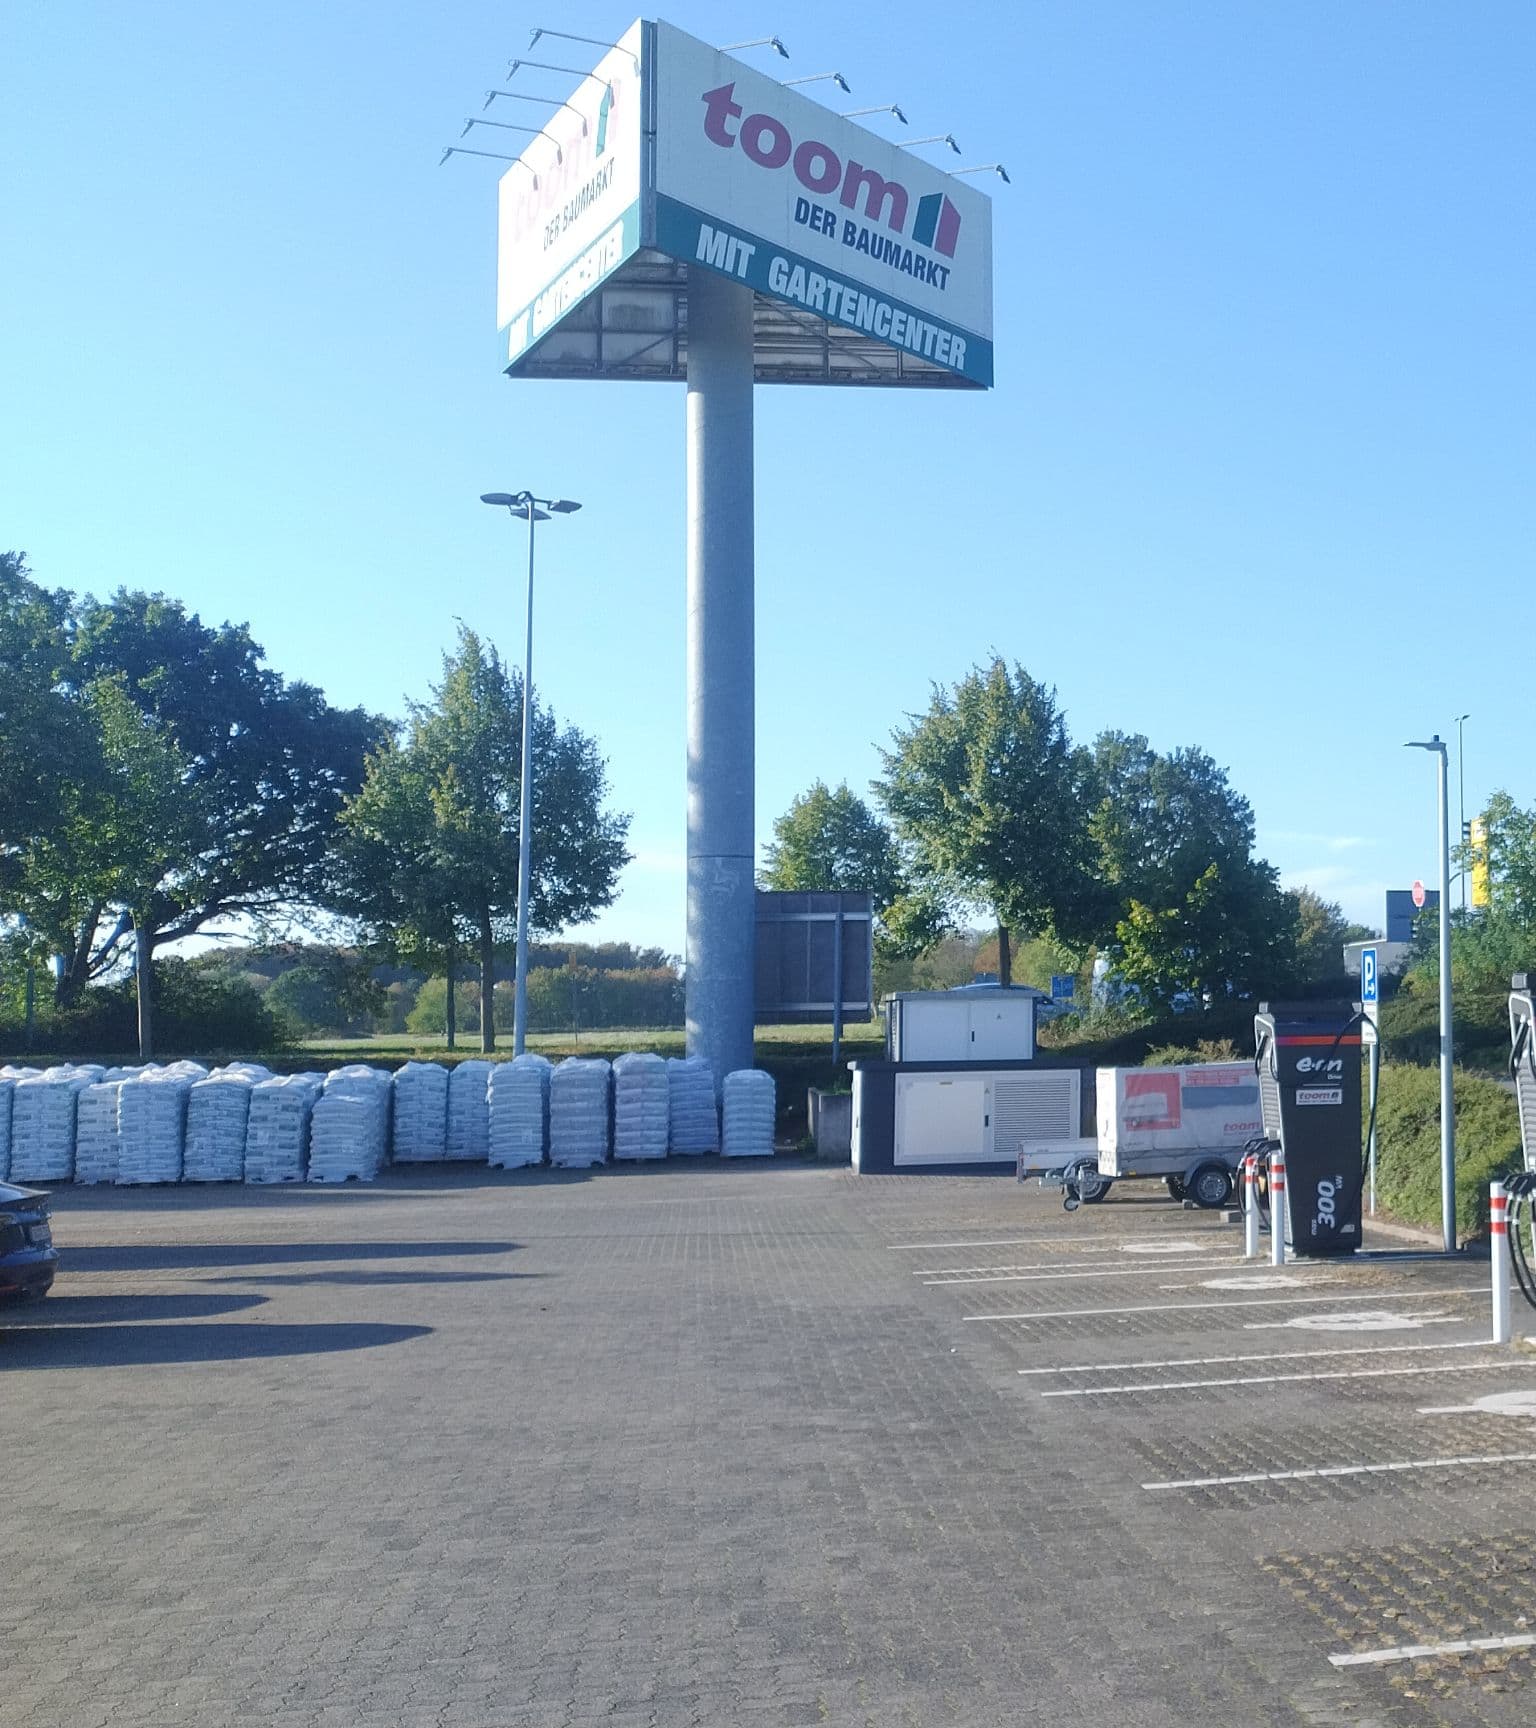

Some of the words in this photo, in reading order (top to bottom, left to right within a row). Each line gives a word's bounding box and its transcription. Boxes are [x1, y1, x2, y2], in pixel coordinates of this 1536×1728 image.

[543, 213, 561, 252] DER
[562, 157, 616, 234] BAUMARKT
[701, 81, 909, 234] toom
[795, 197, 837, 240] DER
[843, 219, 950, 291] BAUMARKT
[696, 223, 756, 278] MIT
[769, 256, 967, 370] GARTENCENTER
[1317, 1181, 1335, 1229] 300
